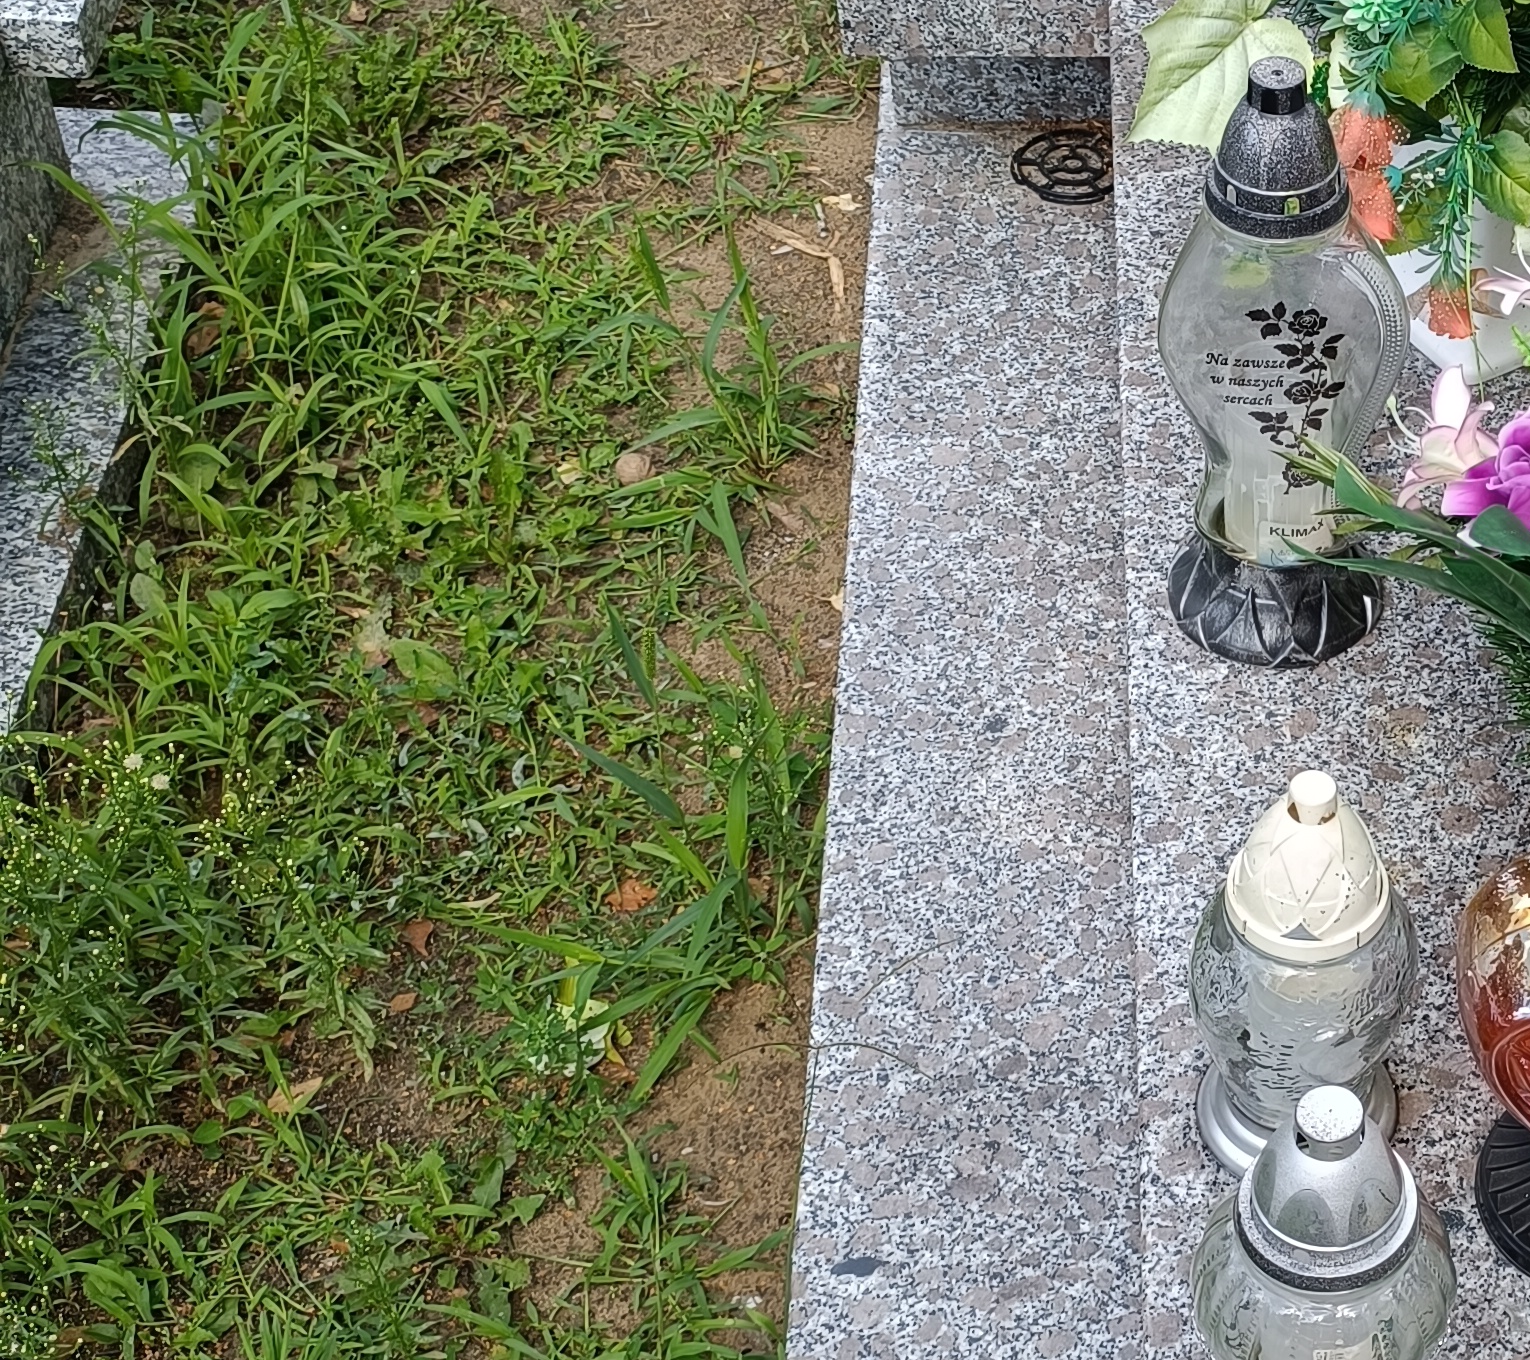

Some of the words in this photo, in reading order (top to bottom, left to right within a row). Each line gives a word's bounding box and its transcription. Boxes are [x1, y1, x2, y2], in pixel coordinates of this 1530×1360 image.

[1205, 351, 1229, 366] Na
[1232, 356, 1286, 370] zawsze
[1209, 375, 1224, 386] w
[1228, 375, 1285, 391] naszych
[1223, 392, 1274, 407] sercach
[1268, 517, 1325, 539] KLIMAX
